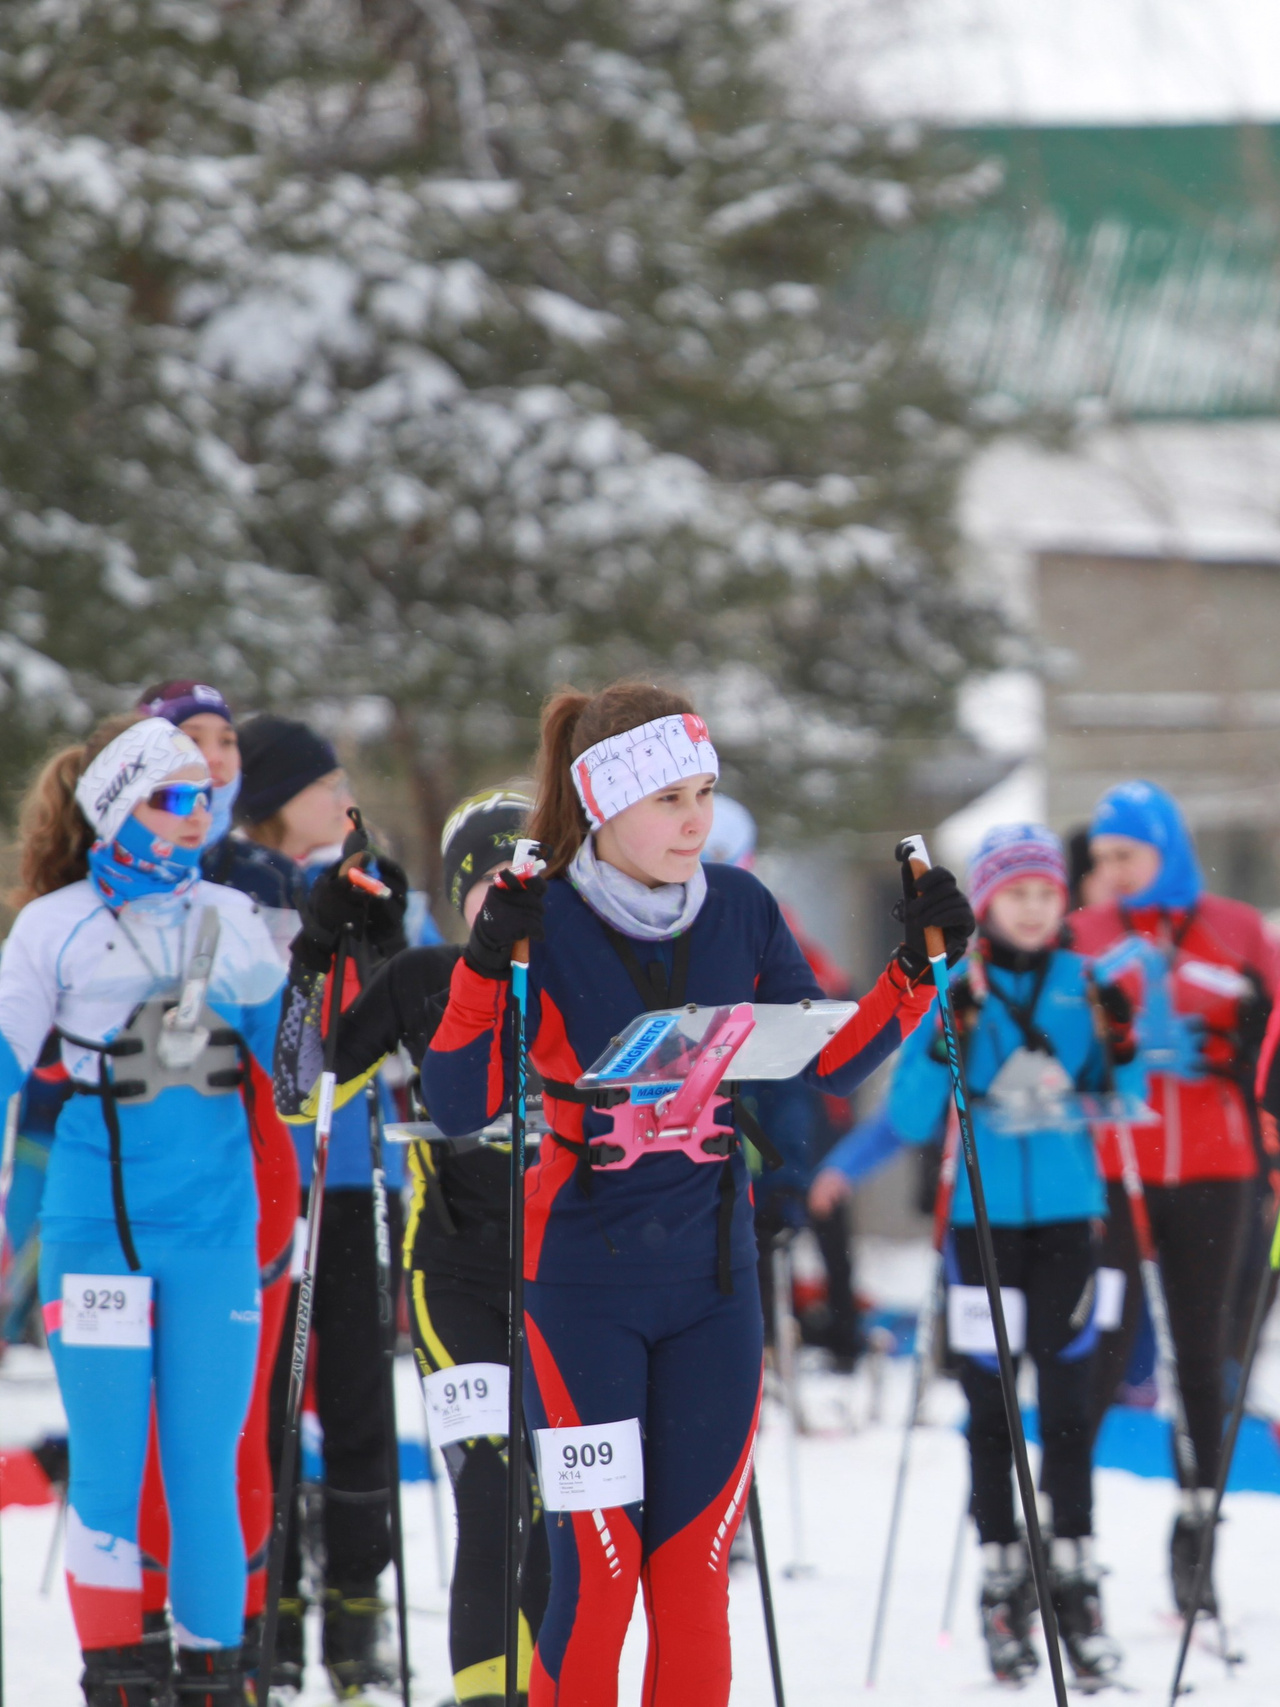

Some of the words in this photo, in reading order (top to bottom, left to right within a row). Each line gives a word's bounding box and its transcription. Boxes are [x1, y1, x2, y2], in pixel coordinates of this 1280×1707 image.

[612, 1020, 667, 1073] MAGNETO
[83, 1290, 126, 1310] 929
[292, 1270, 312, 1380] NORDWAY
[444, 1378, 488, 1404] 919
[562, 1441, 613, 1469] 909
[559, 1470, 582, 1481] Ж14
